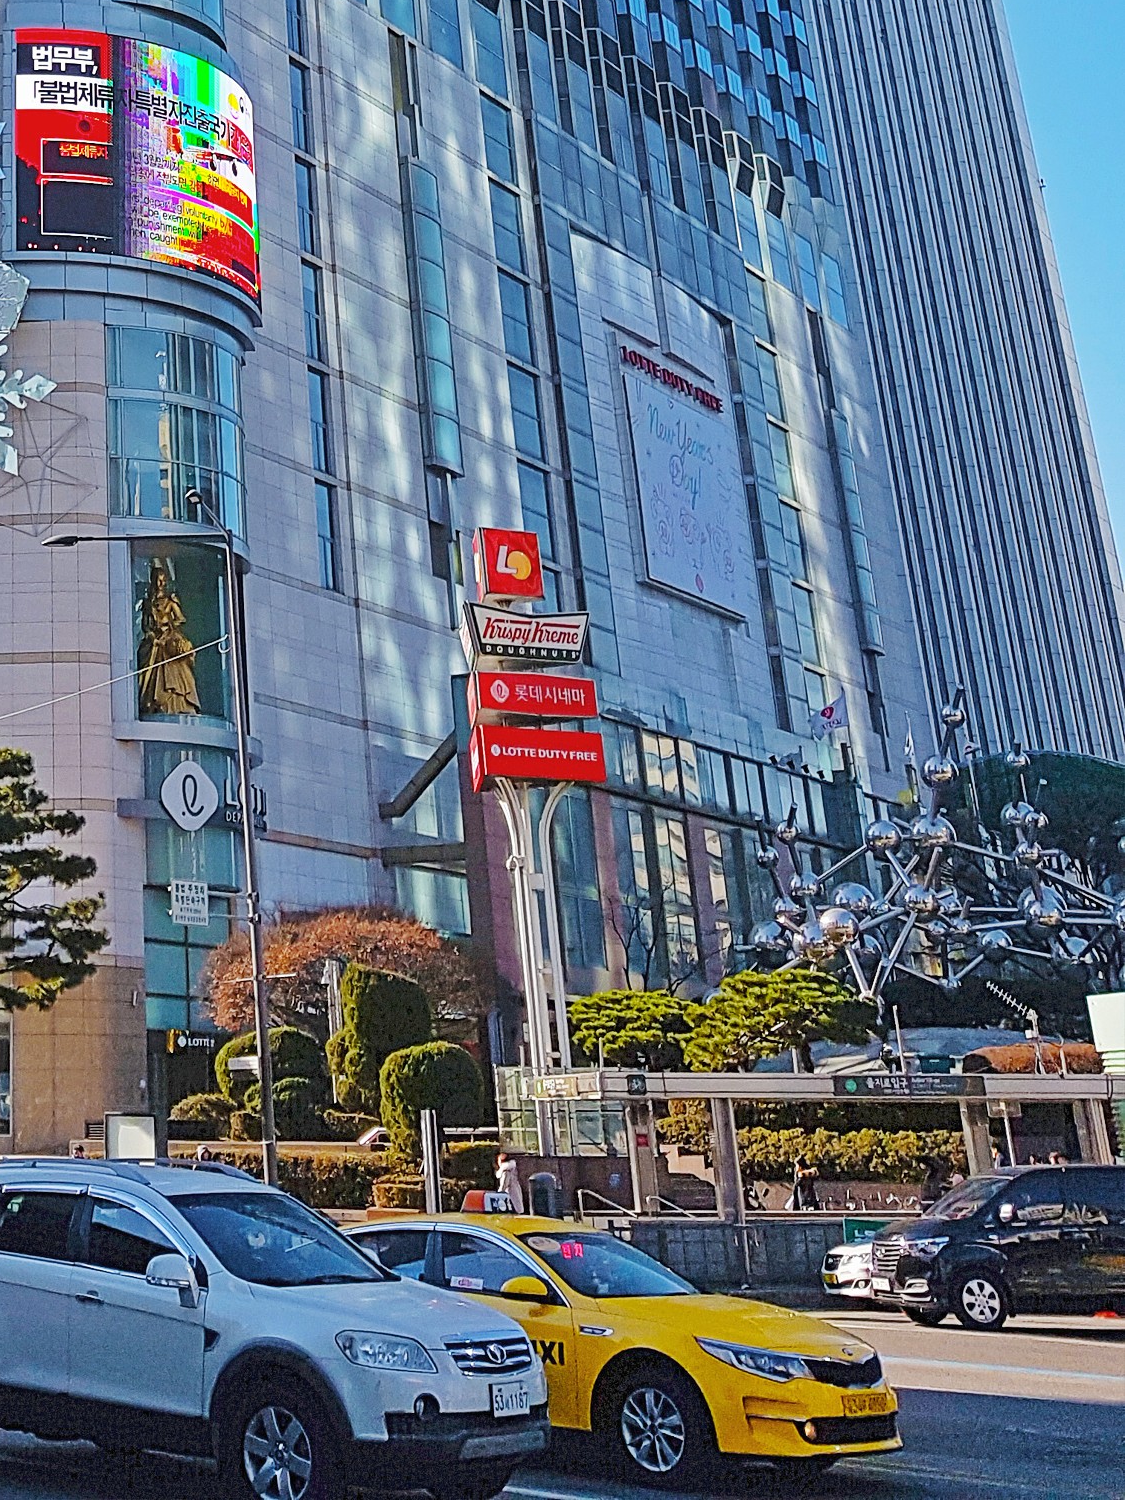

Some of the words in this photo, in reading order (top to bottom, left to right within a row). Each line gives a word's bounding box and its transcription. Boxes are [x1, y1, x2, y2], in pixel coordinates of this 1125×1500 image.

[31, 45, 99, 76] 법무부,
[619, 346, 661, 379] LOTTE
[660, 368, 694, 396] DUTY
[694, 386, 724, 414] FREE
[482, 616, 532, 645] Krispy
[530, 621, 581, 645] Kreme
[485, 645, 578, 659] DOUGHNUTS
[514, 684, 586, 707] 롯데시네마
[502, 746, 536, 757] LOTTE
[538, 748, 568, 760] DUTY
[569, 750, 598, 762] FREE
